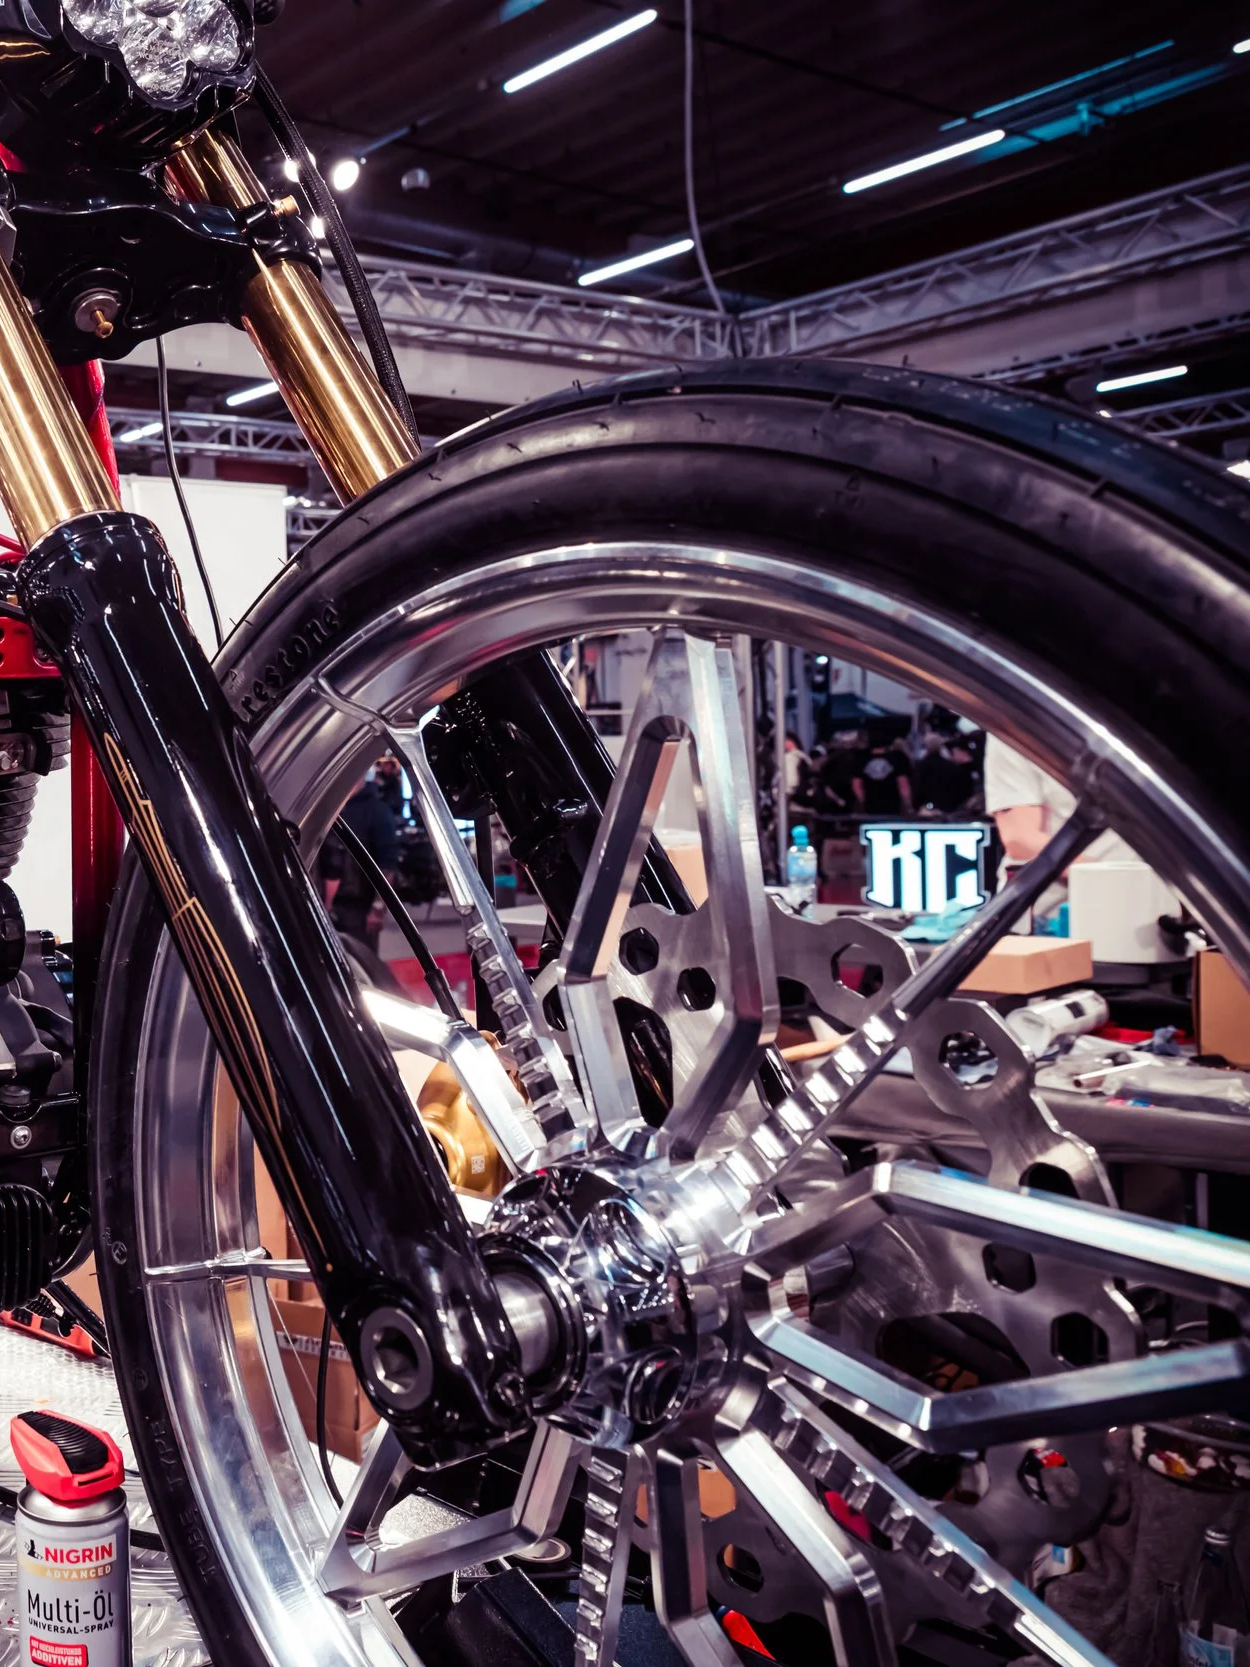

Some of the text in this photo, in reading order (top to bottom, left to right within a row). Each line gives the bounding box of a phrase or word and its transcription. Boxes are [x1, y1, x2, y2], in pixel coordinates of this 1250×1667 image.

[866, 830, 984, 911] KC
[44, 1542, 113, 1564] NIGRIN
[45, 1565, 112, 1579] ADVANCED
[28, 1589, 114, 1623] Multi-Öl
[28, 1618, 114, 1634] UNIVERSAL-SPRAY
[32, 1649, 82, 1665] ADDITIVEN
